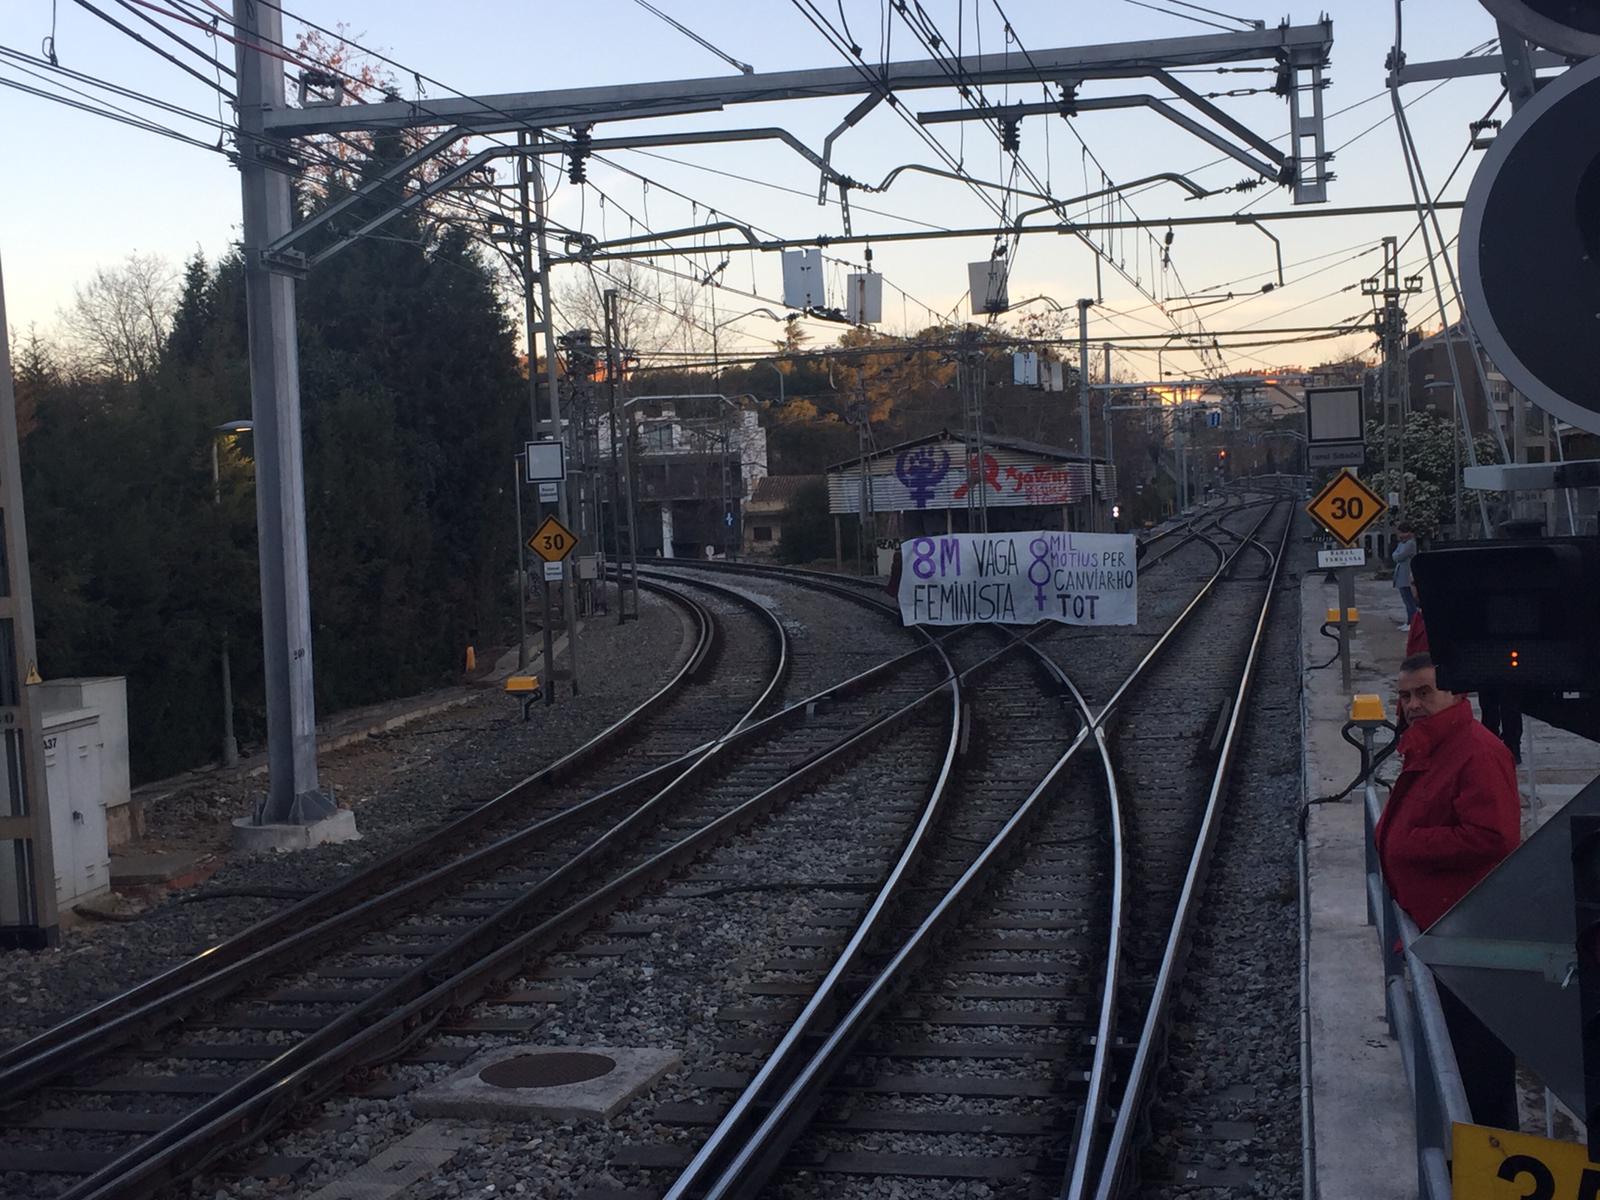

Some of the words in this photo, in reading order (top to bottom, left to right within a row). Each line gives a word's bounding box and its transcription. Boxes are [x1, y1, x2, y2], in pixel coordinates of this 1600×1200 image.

[1330, 496, 1364, 520] 30
[543, 533, 565, 551] 30
[1050, 533, 1077, 551] MIL
[913, 537, 961, 579] 8M
[972, 538, 1019, 578] VAGA
[1050, 552, 1099, 568] MOTIUS
[1103, 551, 1126, 567] PER
[914, 581, 1017, 621] FEMINISTA
[1057, 594, 1099, 620] TOT
